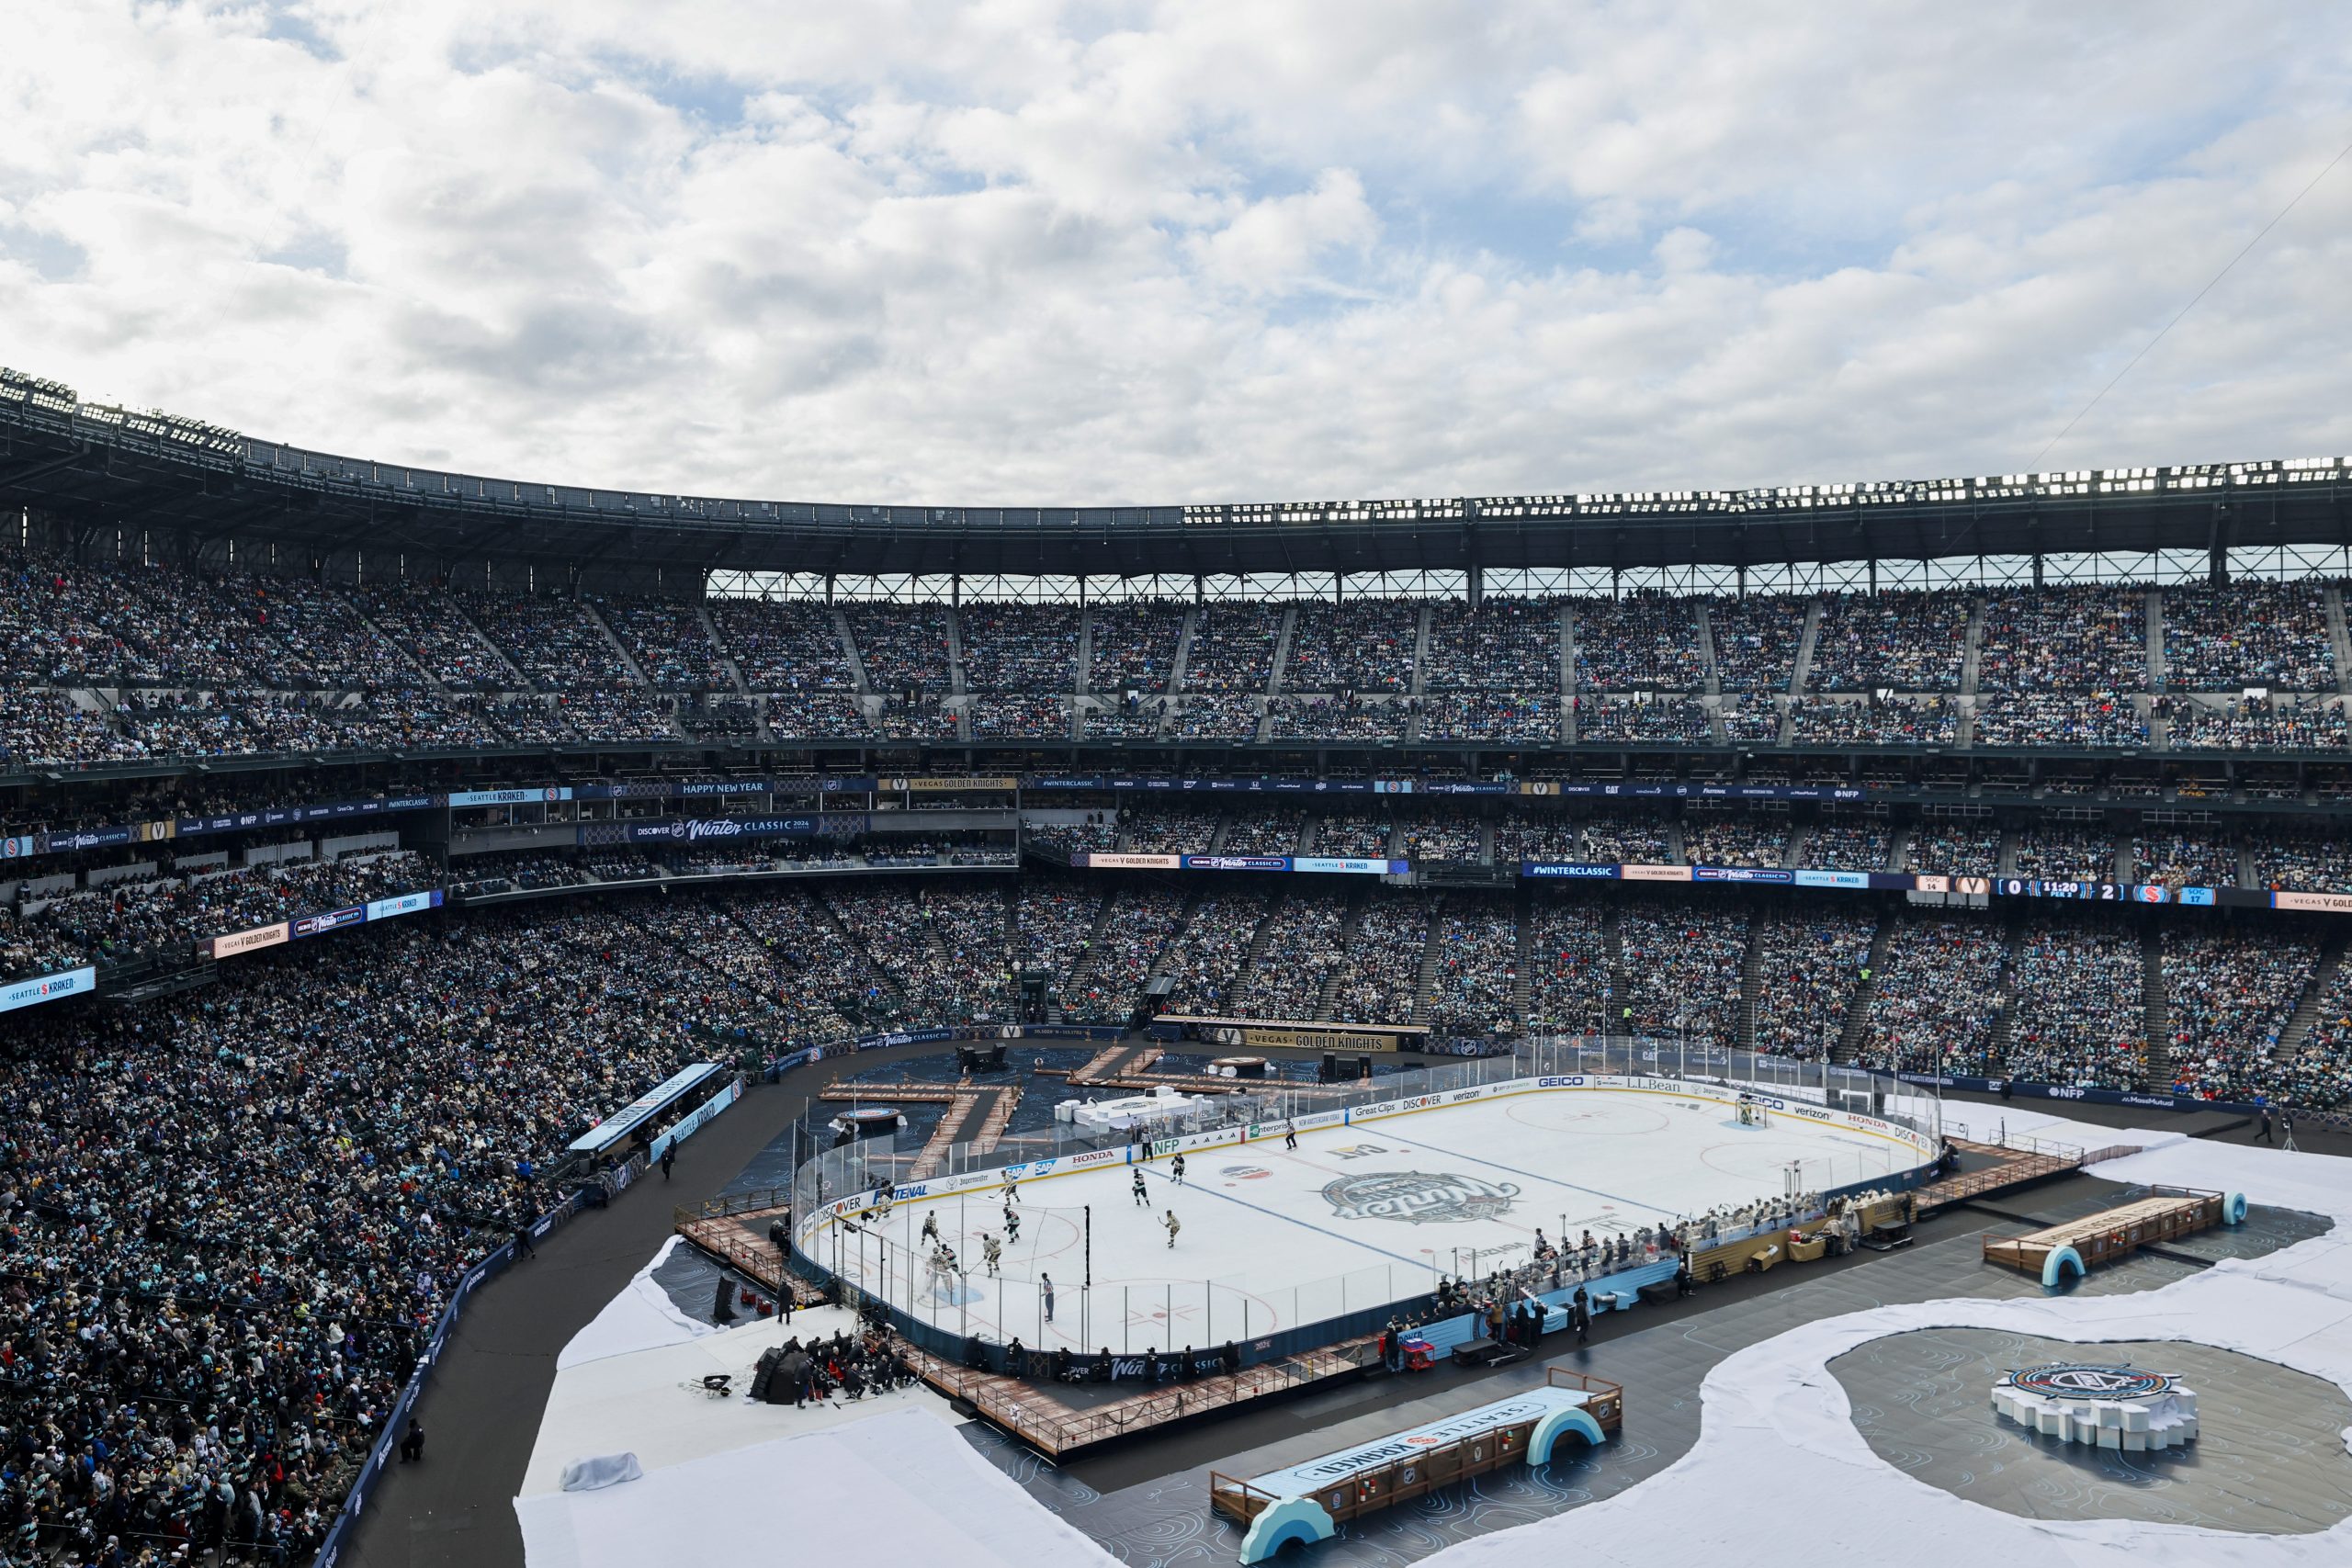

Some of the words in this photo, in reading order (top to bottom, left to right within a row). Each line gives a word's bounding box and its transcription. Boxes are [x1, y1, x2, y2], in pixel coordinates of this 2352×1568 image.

[684, 784, 715, 794] HAPPY
[717, 784, 738, 793] NEW
[740, 783, 763, 792] YEAR
[944, 780, 971, 788] GOLDEN
[973, 780, 1003, 788] KNIGHTS
[1605, 785, 1620, 794] CAT
[389, 798, 429, 808] #WINTERCLASSIC
[469, 794, 497, 802] SEATTLE
[497, 791, 525, 802] KRAKEN
[638, 827, 670, 835] DISCOVER
[686, 818, 742, 840] Winter
[744, 820, 791, 831] CLASSIC
[99, 833, 119, 841] CLASSIC
[1220, 857, 1248, 871] Winter
[1533, 866, 1612, 876] #WINTERCLASSIC
[2008, 880, 2021, 895] 0
[2043, 882, 2078, 893] 11:20
[2102, 885, 2113, 899] 2
[336, 912, 354, 922] CLASSIC
[224, 940, 240, 949] VEGAS
[245, 933, 262, 945] GOLDEN
[263, 930, 280, 942] KNIGHTS
[12, 987, 40, 1001] SEATTLE
[49, 978, 74, 994] KRAKEN
[883, 1035, 913, 1047] Winter
[1255, 1035, 1287, 1043] VEGAS
[1296, 1036, 1335, 1048] GOLDEN
[1338, 1037, 1382, 1050] KNIGHTS
[1539, 1077, 1584, 1087] GEICO
[1627, 1077, 1680, 1093] L.L.Bean
[1453, 1090, 1479, 1101] verizon
[2060, 1088, 2085, 1099] NFP
[1404, 1095, 1442, 1110] DISCOVER
[2131, 1096, 2174, 1107] MassMutual
[1356, 1107, 1377, 1117] Great
[1378, 1103, 1396, 1114] Clips
[1795, 1106, 1829, 1120] verizon
[675, 1122, 695, 1141] SEATTLE
[697, 1102, 715, 1126] KRAKEN
[1307, 1116, 1329, 1125] AMSTERDAM
[1848, 1114, 1888, 1129] HONDA
[1250, 1122, 1288, 1137] enterpris
[1154, 1138, 1180, 1156] NFP
[1326, 1143, 1389, 1161] CAT
[1072, 1151, 1114, 1164] HONDA
[1006, 1167, 1023, 1179] SAP
[1035, 1161, 1053, 1174] SAP
[873, 1185, 928, 1205] FTENAL
[1332, 1173, 1521, 1219] Winter
[820, 1197, 861, 1223] DISCOVER
[534, 1220, 551, 1237] verizon
[1470, 1241, 1529, 1259] verizon
[1432, 1407, 1522, 1438] SEATTLE
[1321, 1443, 1418, 1474] KRAKEN
